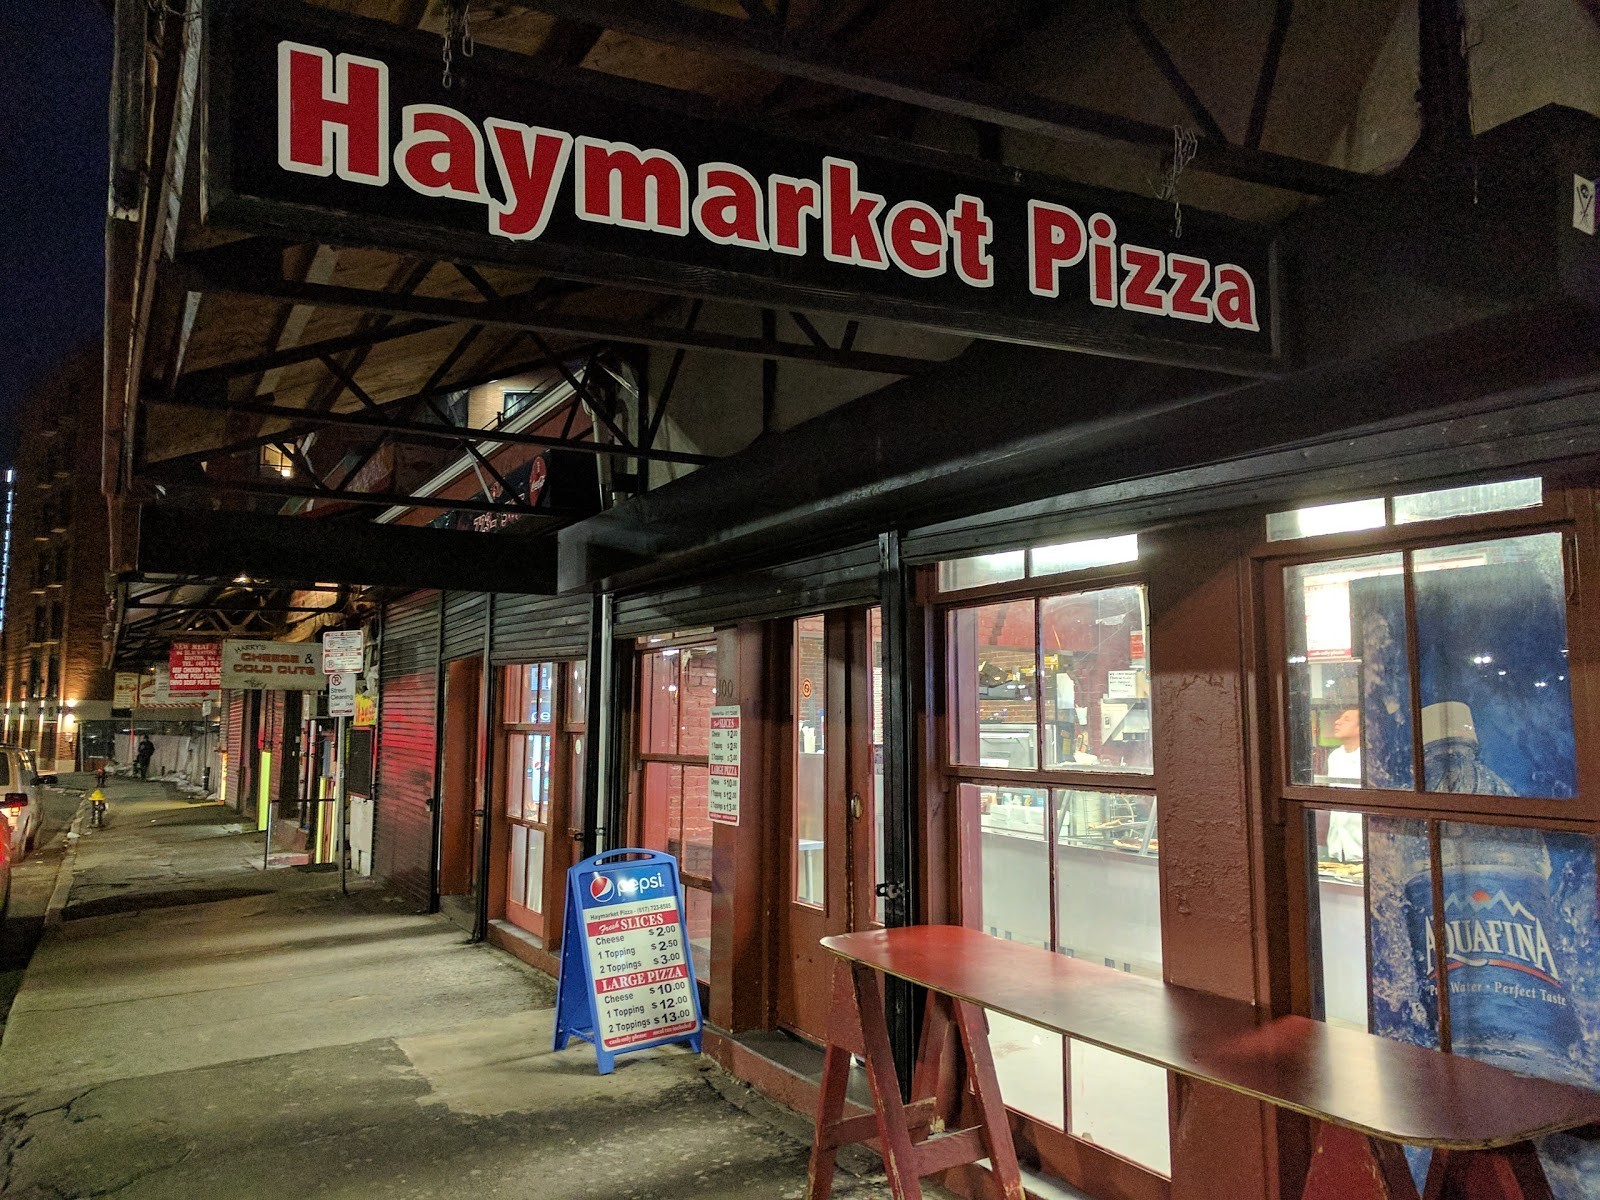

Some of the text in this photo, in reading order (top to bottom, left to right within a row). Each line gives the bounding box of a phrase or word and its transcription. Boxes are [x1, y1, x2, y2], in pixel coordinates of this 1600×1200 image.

[278, 40, 1260, 332] Haymarket Pizza
[241, 652, 300, 664] CHEESE
[304, 653, 314, 664] &
[233, 664, 316, 676] COLD CUTS
[617, 873, 663, 896] pepsi
[590, 911, 619, 921] Haymarket
[599, 913, 664, 934] Fresh SLICES
[595, 935, 625, 946] Cheese
[1425, 914, 1561, 981] AQUAFINA
[597, 952, 602, 960] 1
[605, 947, 636, 959] Topping
[599, 965, 605, 974] 2
[607, 960, 642, 973] Toppings
[601, 966, 683, 991] LARGE PIZZA
[604, 993, 634, 1004] Cheese
[1451, 981, 1483, 993] Water
[1493, 981, 1537, 999] Perfect
[1539, 988, 1567, 1006] Taste
[606, 1011, 611, 1019] 1
[613, 1004, 645, 1017] Topping
[608, 1024, 614, 1033] 2
[615, 1018, 651, 1032] Toppings
